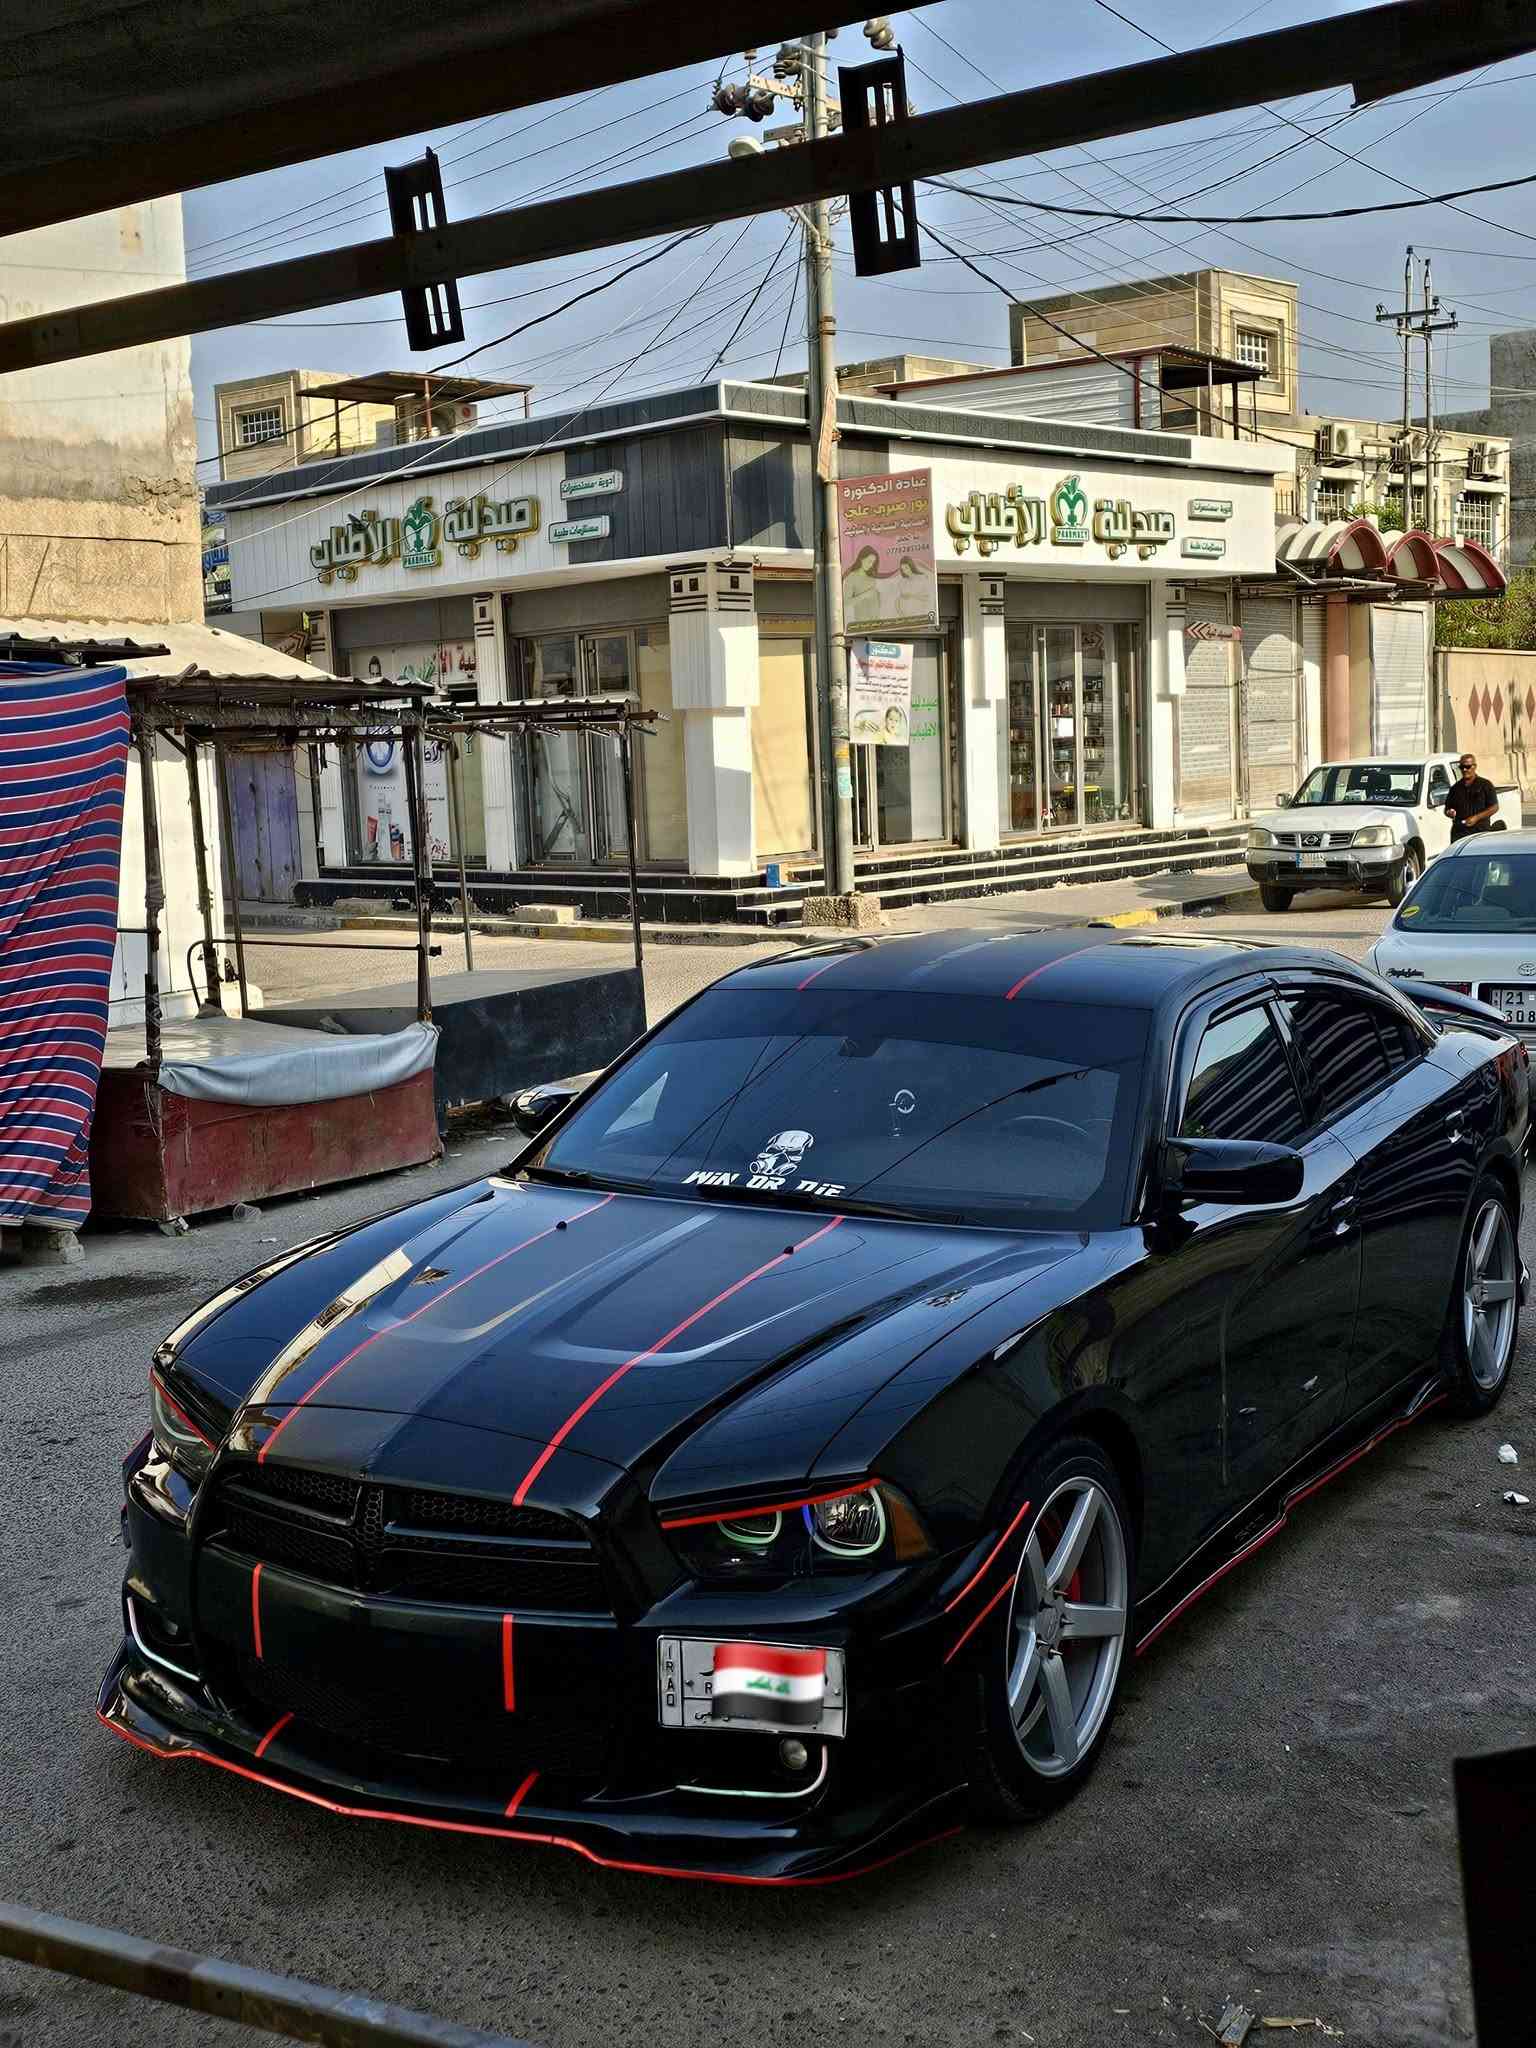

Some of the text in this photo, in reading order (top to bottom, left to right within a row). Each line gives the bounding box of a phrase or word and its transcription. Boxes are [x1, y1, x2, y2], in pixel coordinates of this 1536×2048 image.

[843, 476, 927, 501] عيادة الدكتورة
[844, 503, 871, 522] علي
[443, 495, 540, 561] صيدلية
[1093, 498, 1175, 560] صيدلية
[1505, 991, 1524, 1005] 21
[746, 1175, 786, 1191] OR
